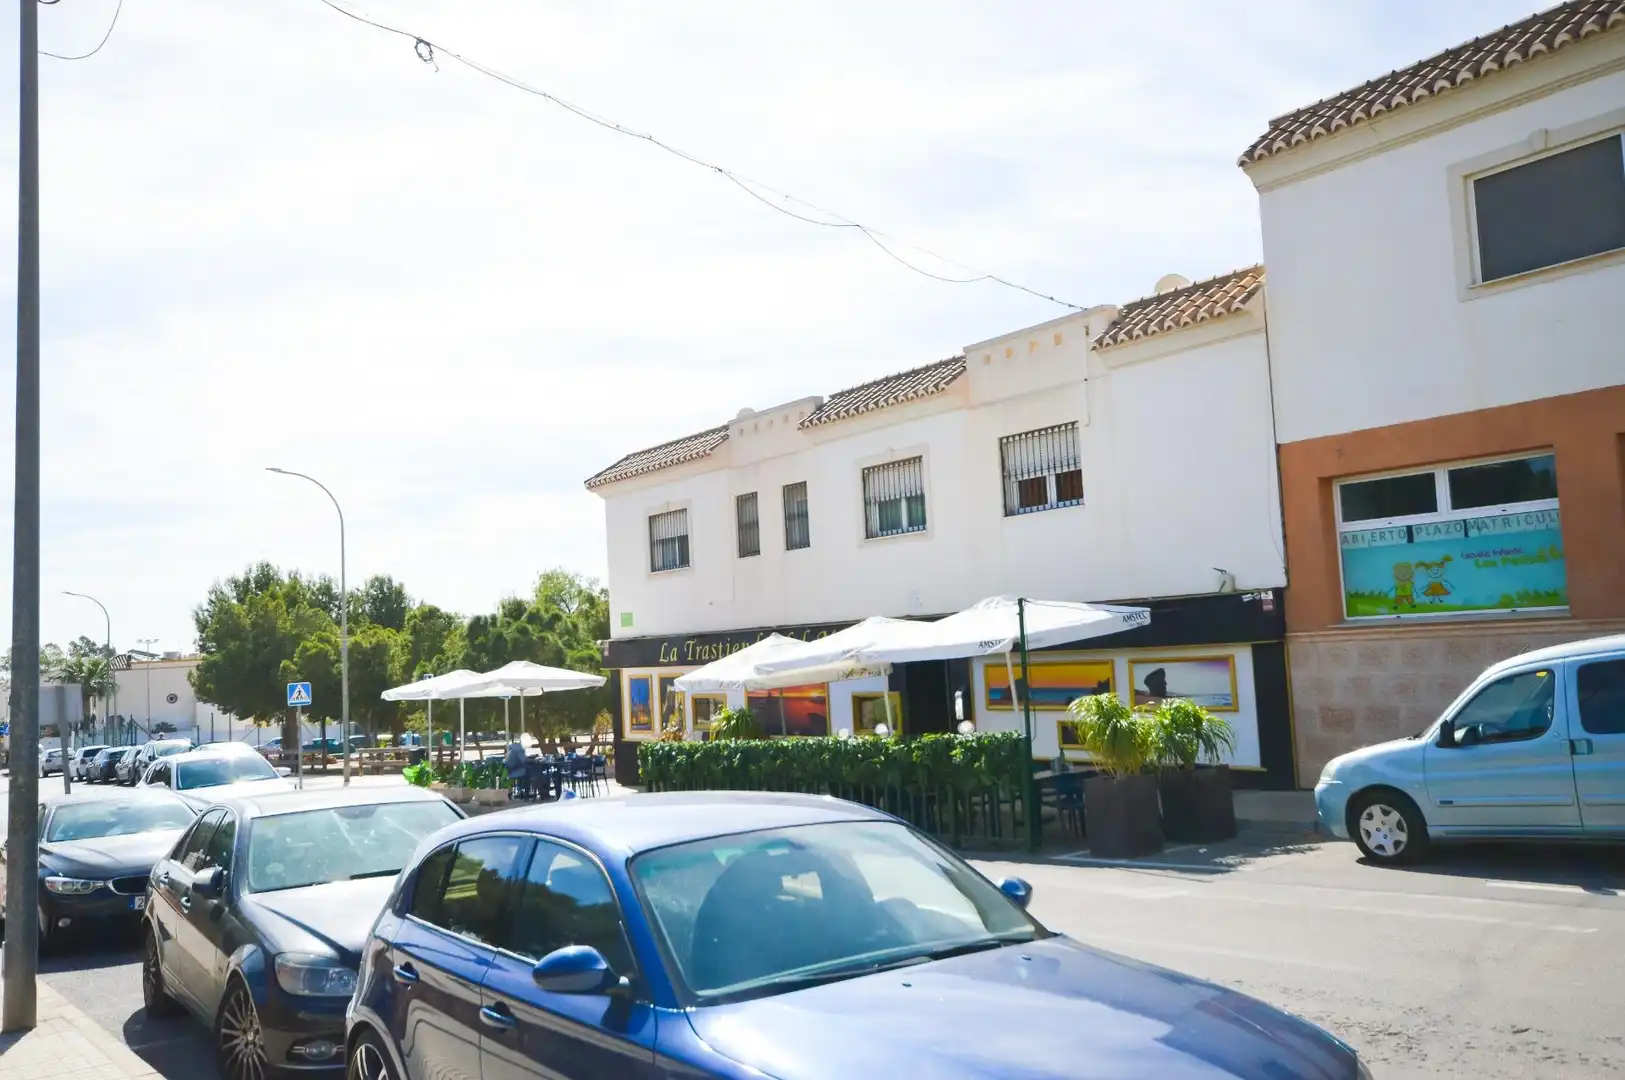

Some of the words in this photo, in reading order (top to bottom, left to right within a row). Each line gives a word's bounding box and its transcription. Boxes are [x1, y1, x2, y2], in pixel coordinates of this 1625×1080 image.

[1341, 528, 1407, 545] ABIERTO
[1416, 521, 1464, 537] PLAZO
[1467, 510, 1561, 531] MATRICUL
[659, 642, 678, 662] La
[684, 632, 764, 661] Trastien
